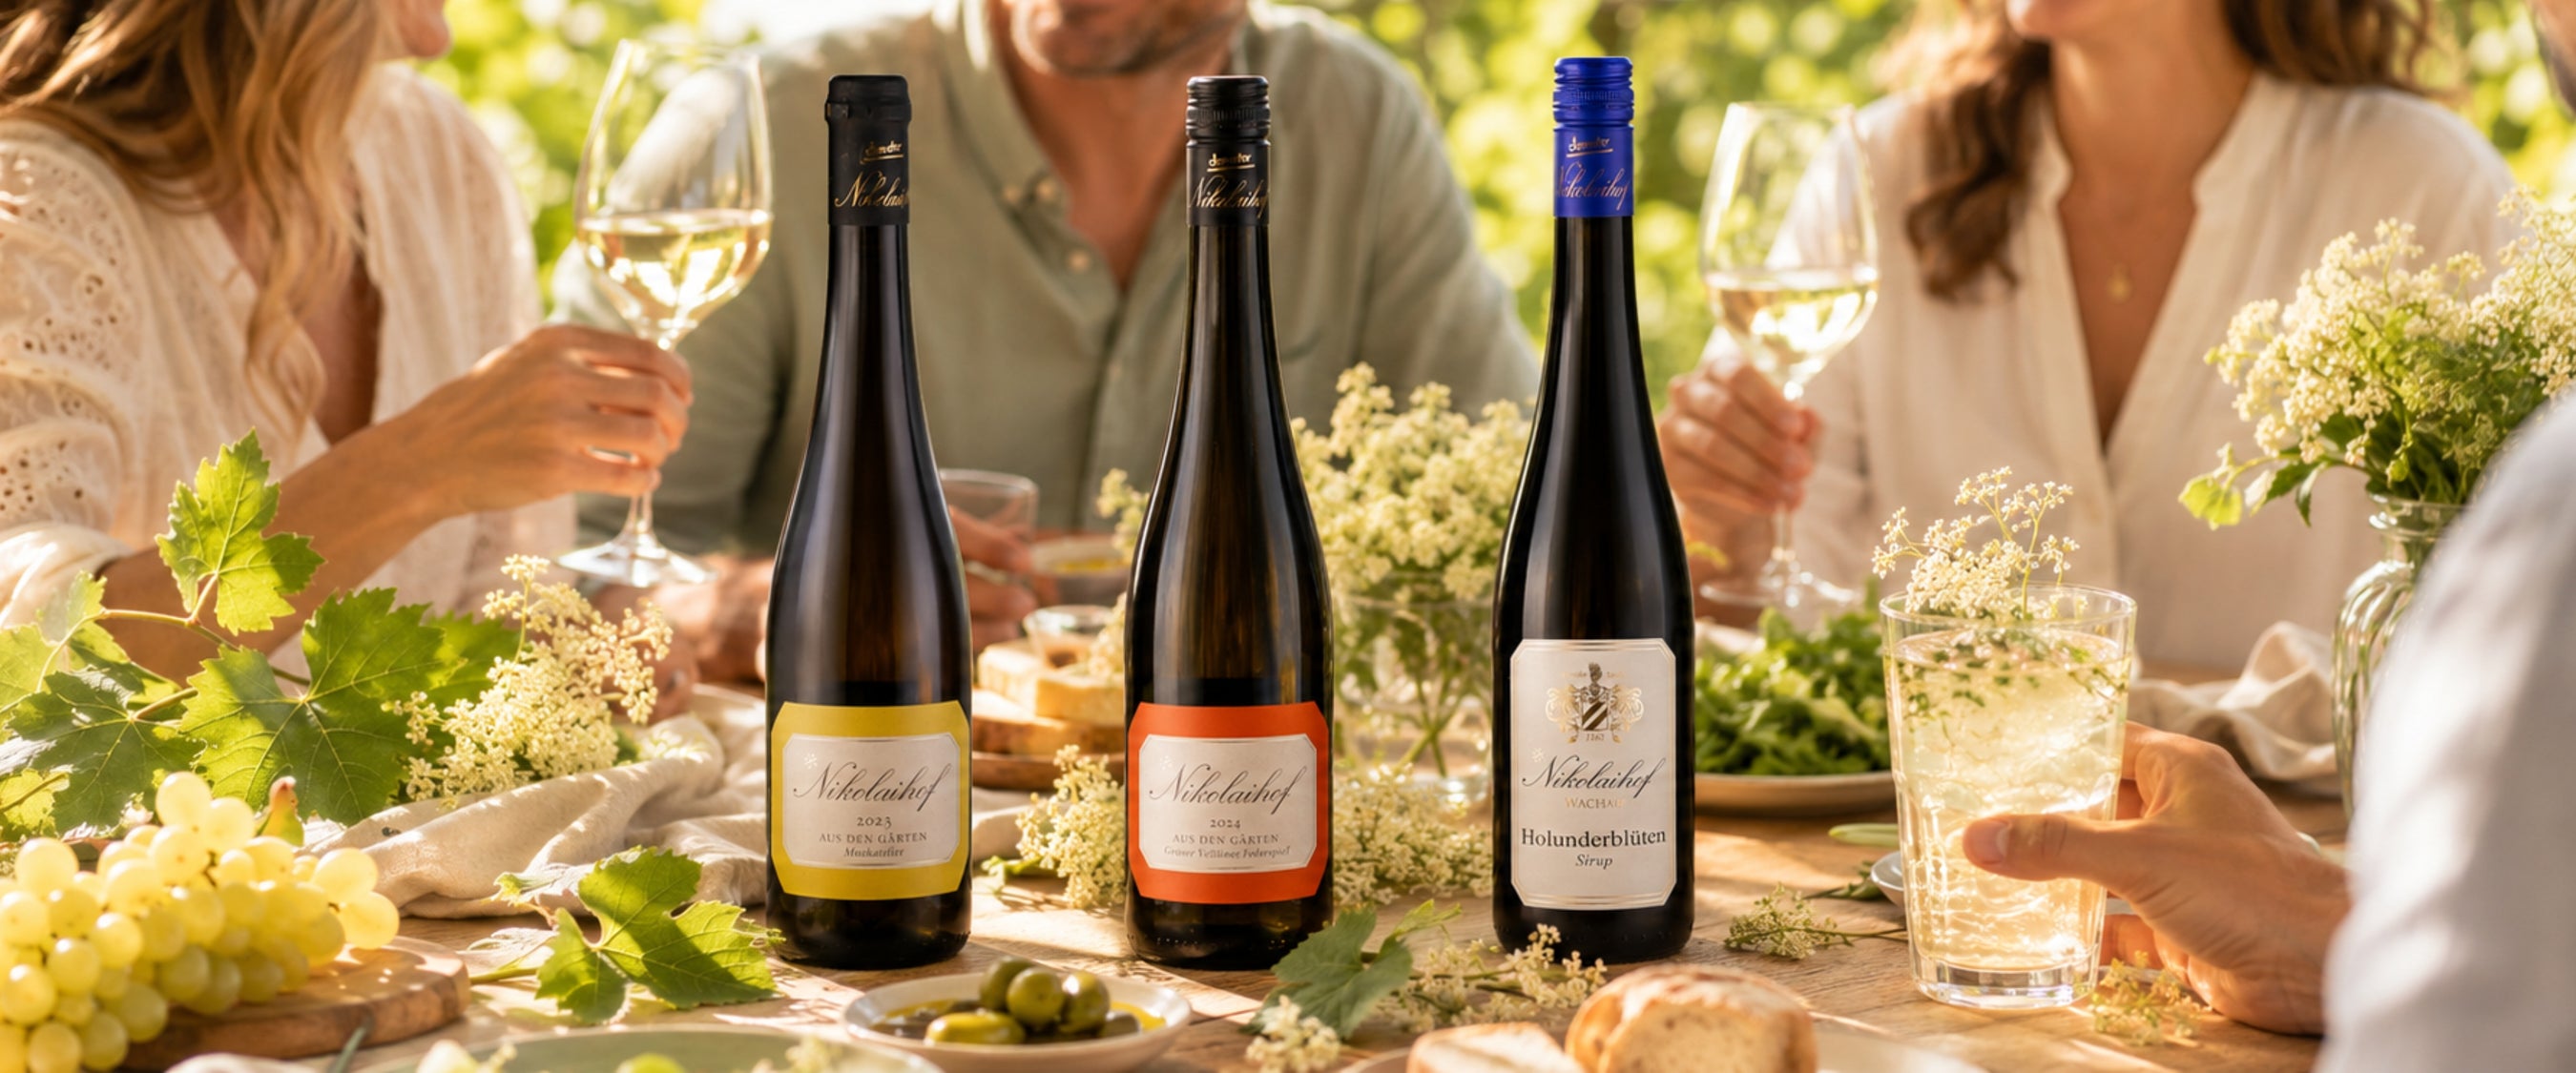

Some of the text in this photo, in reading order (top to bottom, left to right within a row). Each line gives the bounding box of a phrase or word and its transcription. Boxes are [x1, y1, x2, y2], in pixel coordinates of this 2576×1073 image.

[1522, 754, 1667, 798] Nikolaihof
[793, 761, 953, 812] Nikolaihof
[1149, 763, 1308, 815] Nikolaihof
[856, 815, 893, 830] 2023
[1210, 818, 1241, 829] 2024
[819, 832, 927, 844] AUS DEN GÄRTEN
[1173, 833, 1279, 845] AUS DEN GÄRTEN
[1522, 828, 1667, 848] Holunderblüten
[1575, 854, 1613, 870] Sirup
